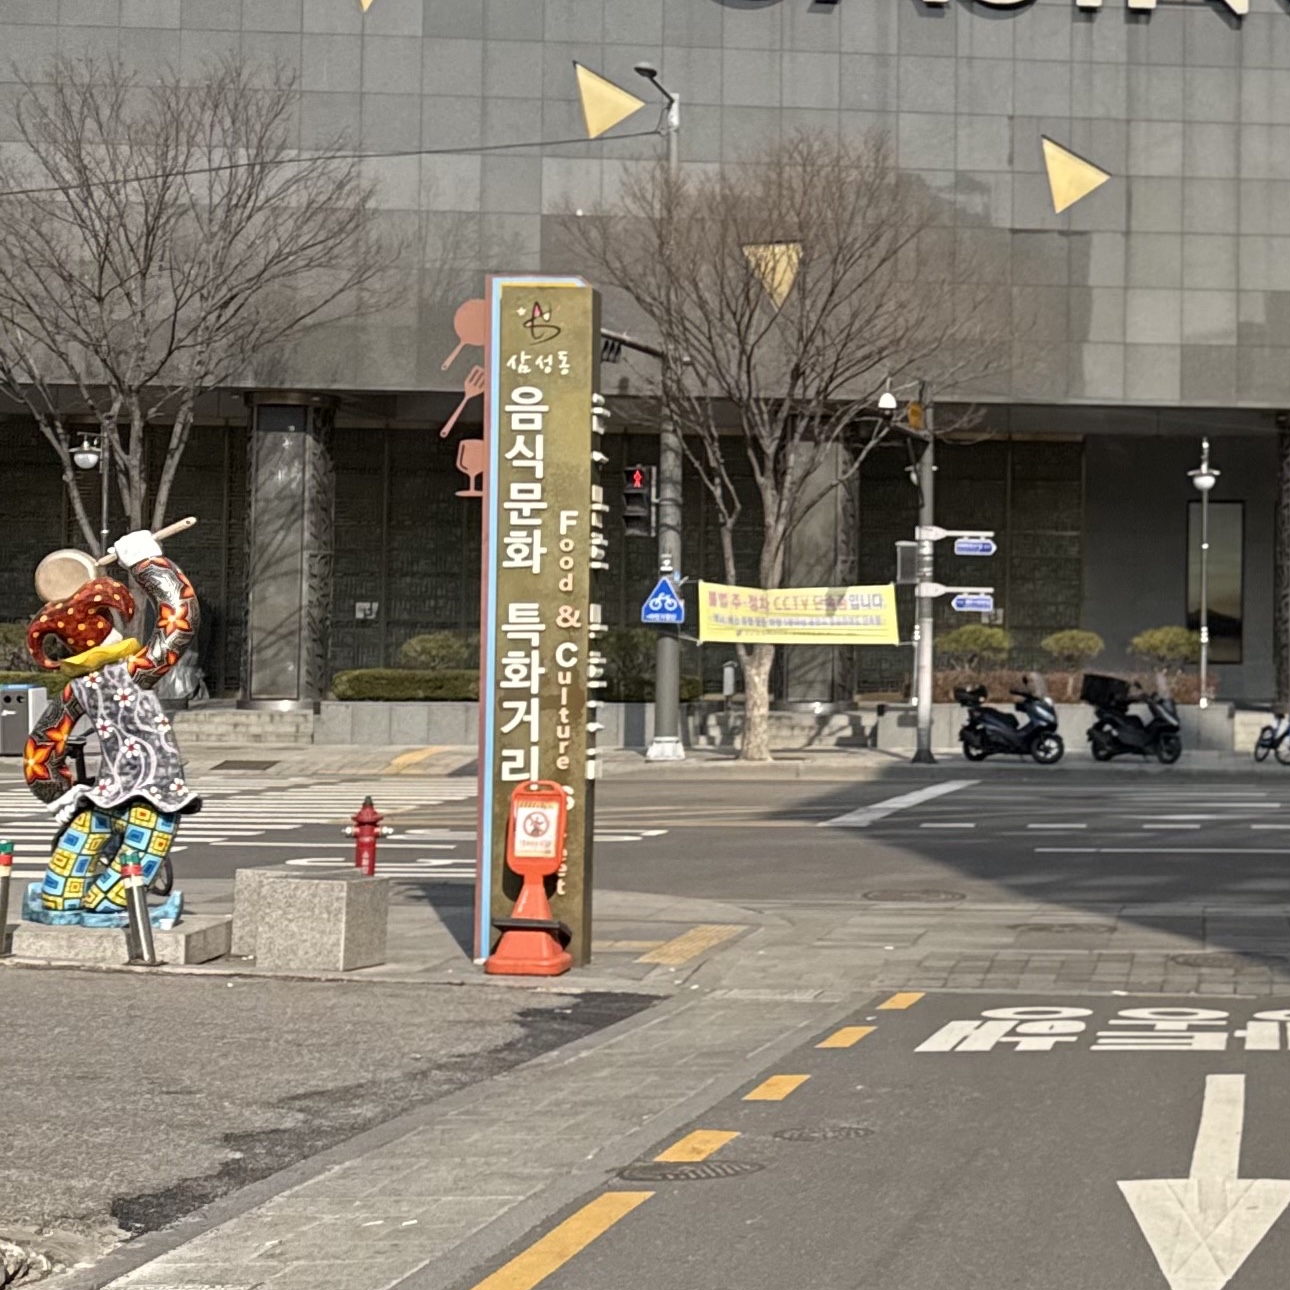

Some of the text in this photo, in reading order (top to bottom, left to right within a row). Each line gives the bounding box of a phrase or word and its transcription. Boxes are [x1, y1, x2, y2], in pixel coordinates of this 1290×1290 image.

[506, 351, 571, 375] 삼성동
[502, 386, 549, 574] 음식문화
[558, 510, 579, 592] Food
[555, 605, 582, 628] &
[500, 602, 546, 791] 특화거리
[555, 642, 579, 770] Culture
